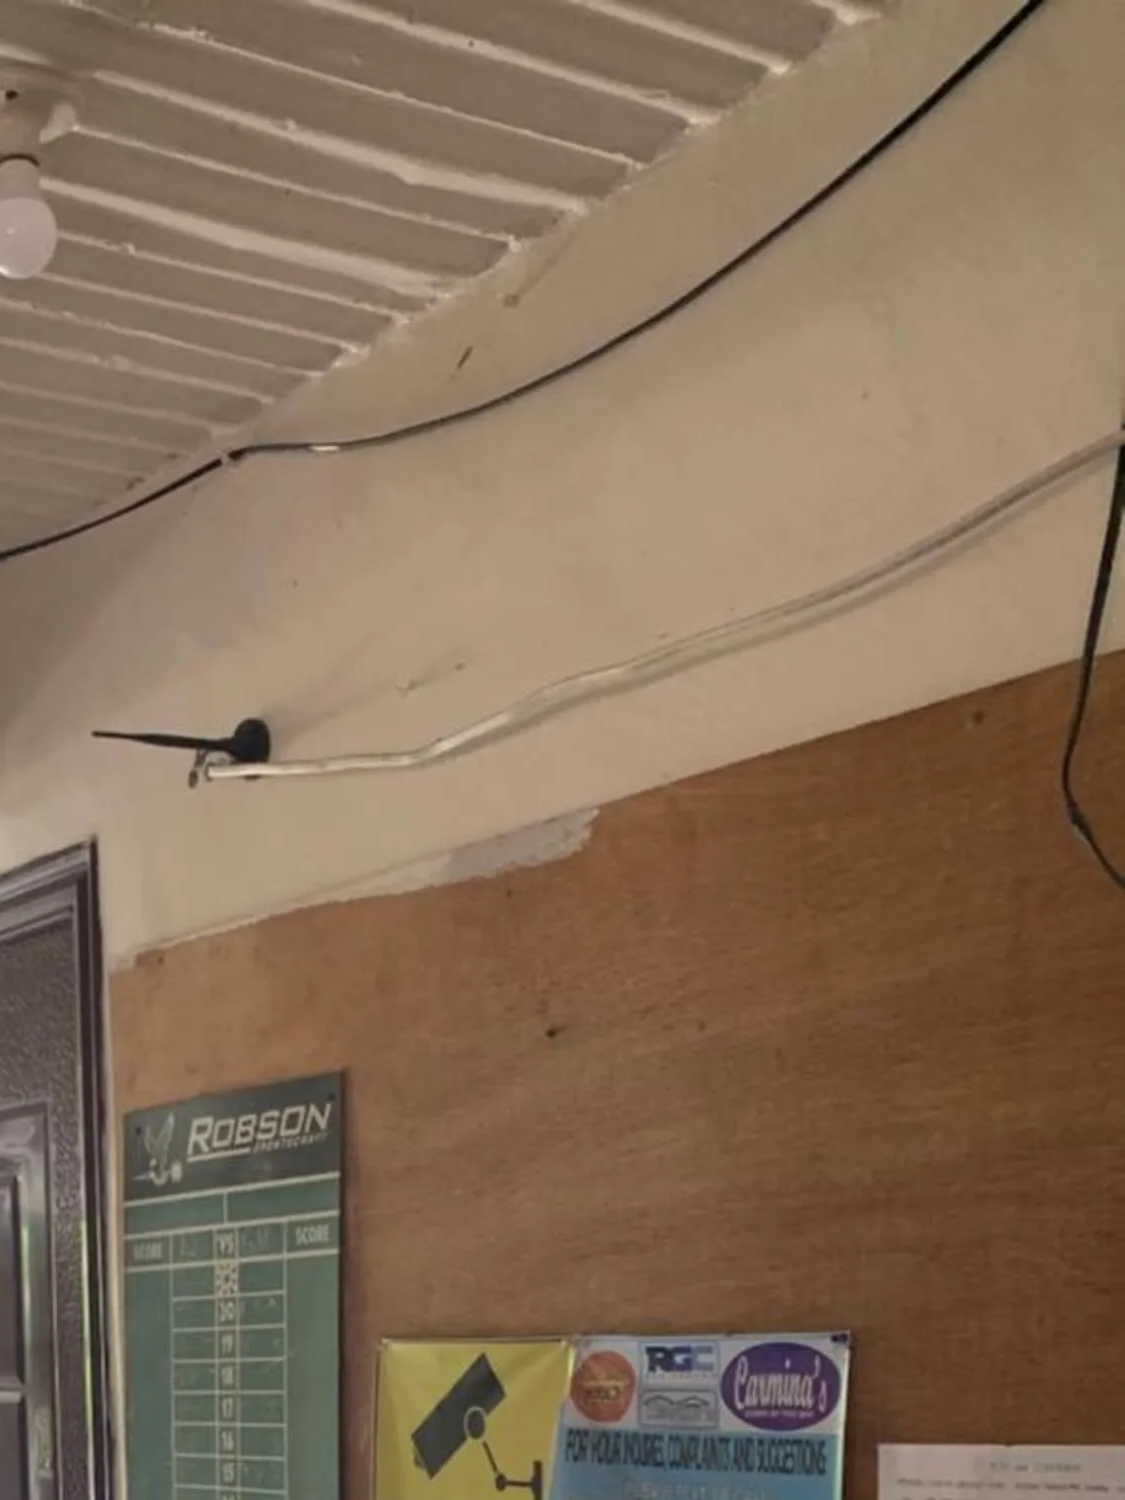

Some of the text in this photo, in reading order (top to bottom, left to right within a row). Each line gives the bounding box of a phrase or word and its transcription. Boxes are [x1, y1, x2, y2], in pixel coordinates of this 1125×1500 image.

[187, 1103, 332, 1155] ROBSON
[295, 1224, 331, 1246] SCORE
[734, 1354, 827, 1414] Carmina's
[565, 1427, 589, 1463] FOR
[591, 1428, 621, 1466] YOUR
[733, 1436, 754, 1472] AND
